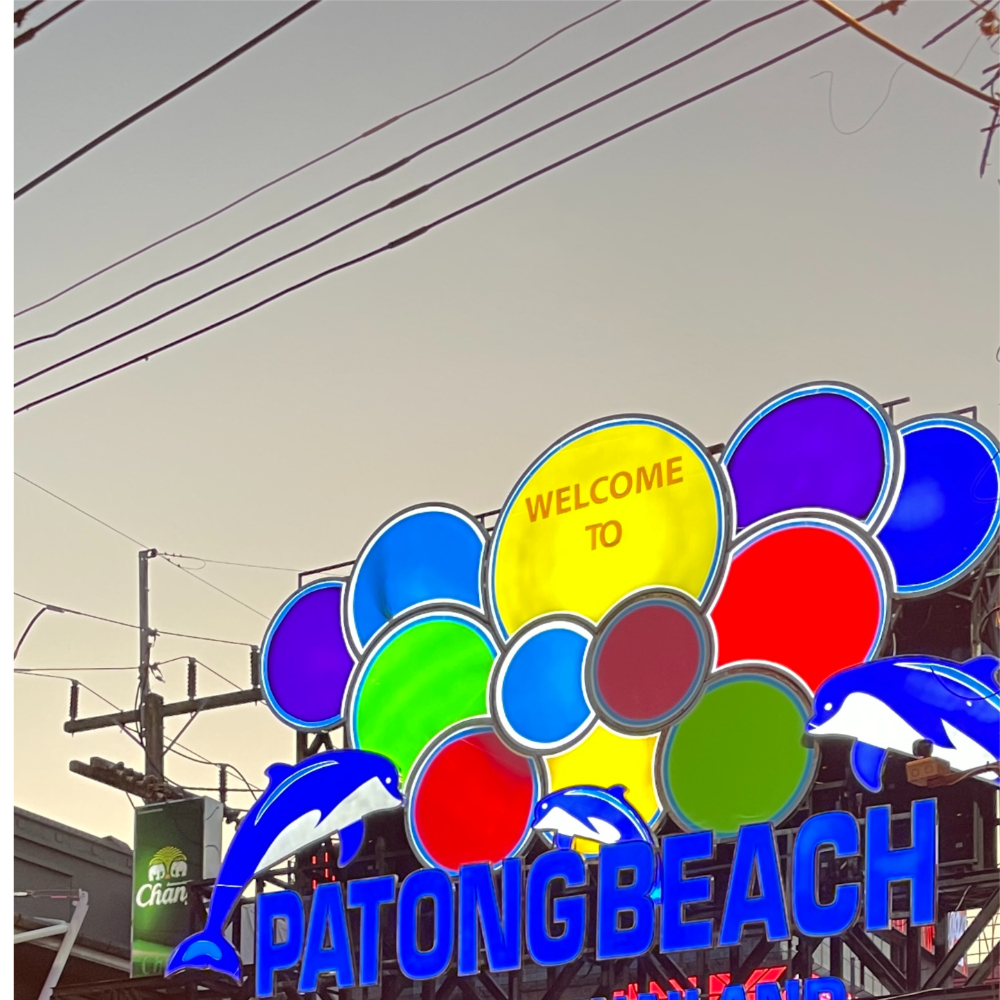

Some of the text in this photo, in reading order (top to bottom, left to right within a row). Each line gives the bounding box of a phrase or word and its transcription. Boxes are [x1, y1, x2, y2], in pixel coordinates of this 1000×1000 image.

[525, 456, 683, 523] WELCOME
[585, 520, 622, 550] TO
[596, 797, 938, 961] BEACH
